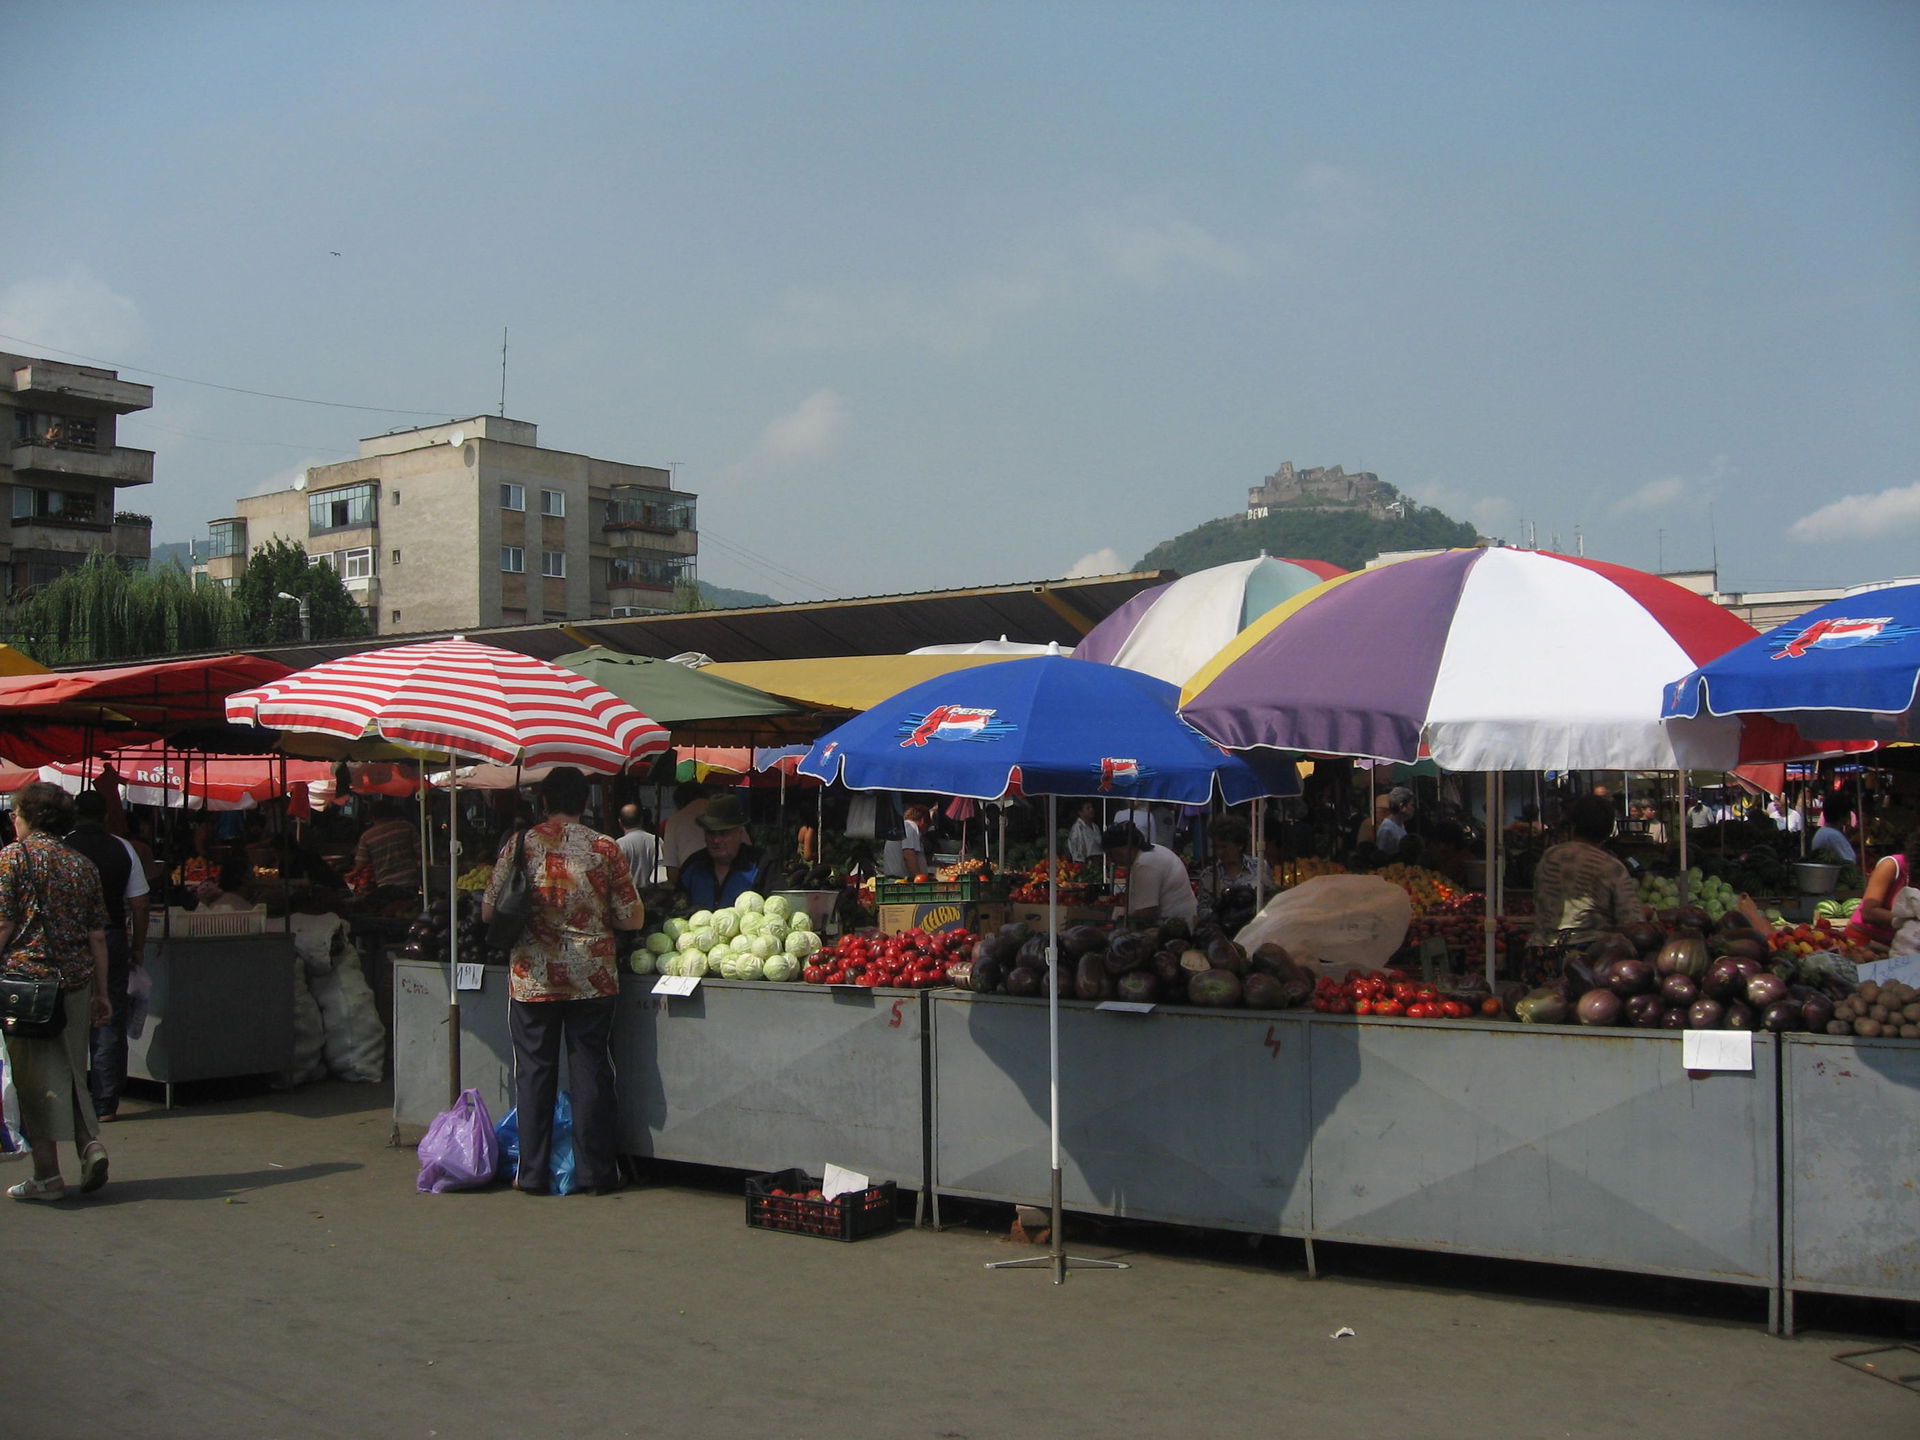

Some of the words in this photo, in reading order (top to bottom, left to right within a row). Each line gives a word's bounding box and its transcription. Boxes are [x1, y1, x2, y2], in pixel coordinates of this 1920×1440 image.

[1247, 506, 1269, 520] DEVA
[948, 706, 997, 716] PEPSI
[888, 999, 904, 1028] 5
[1263, 1025, 1281, 1059] 4
